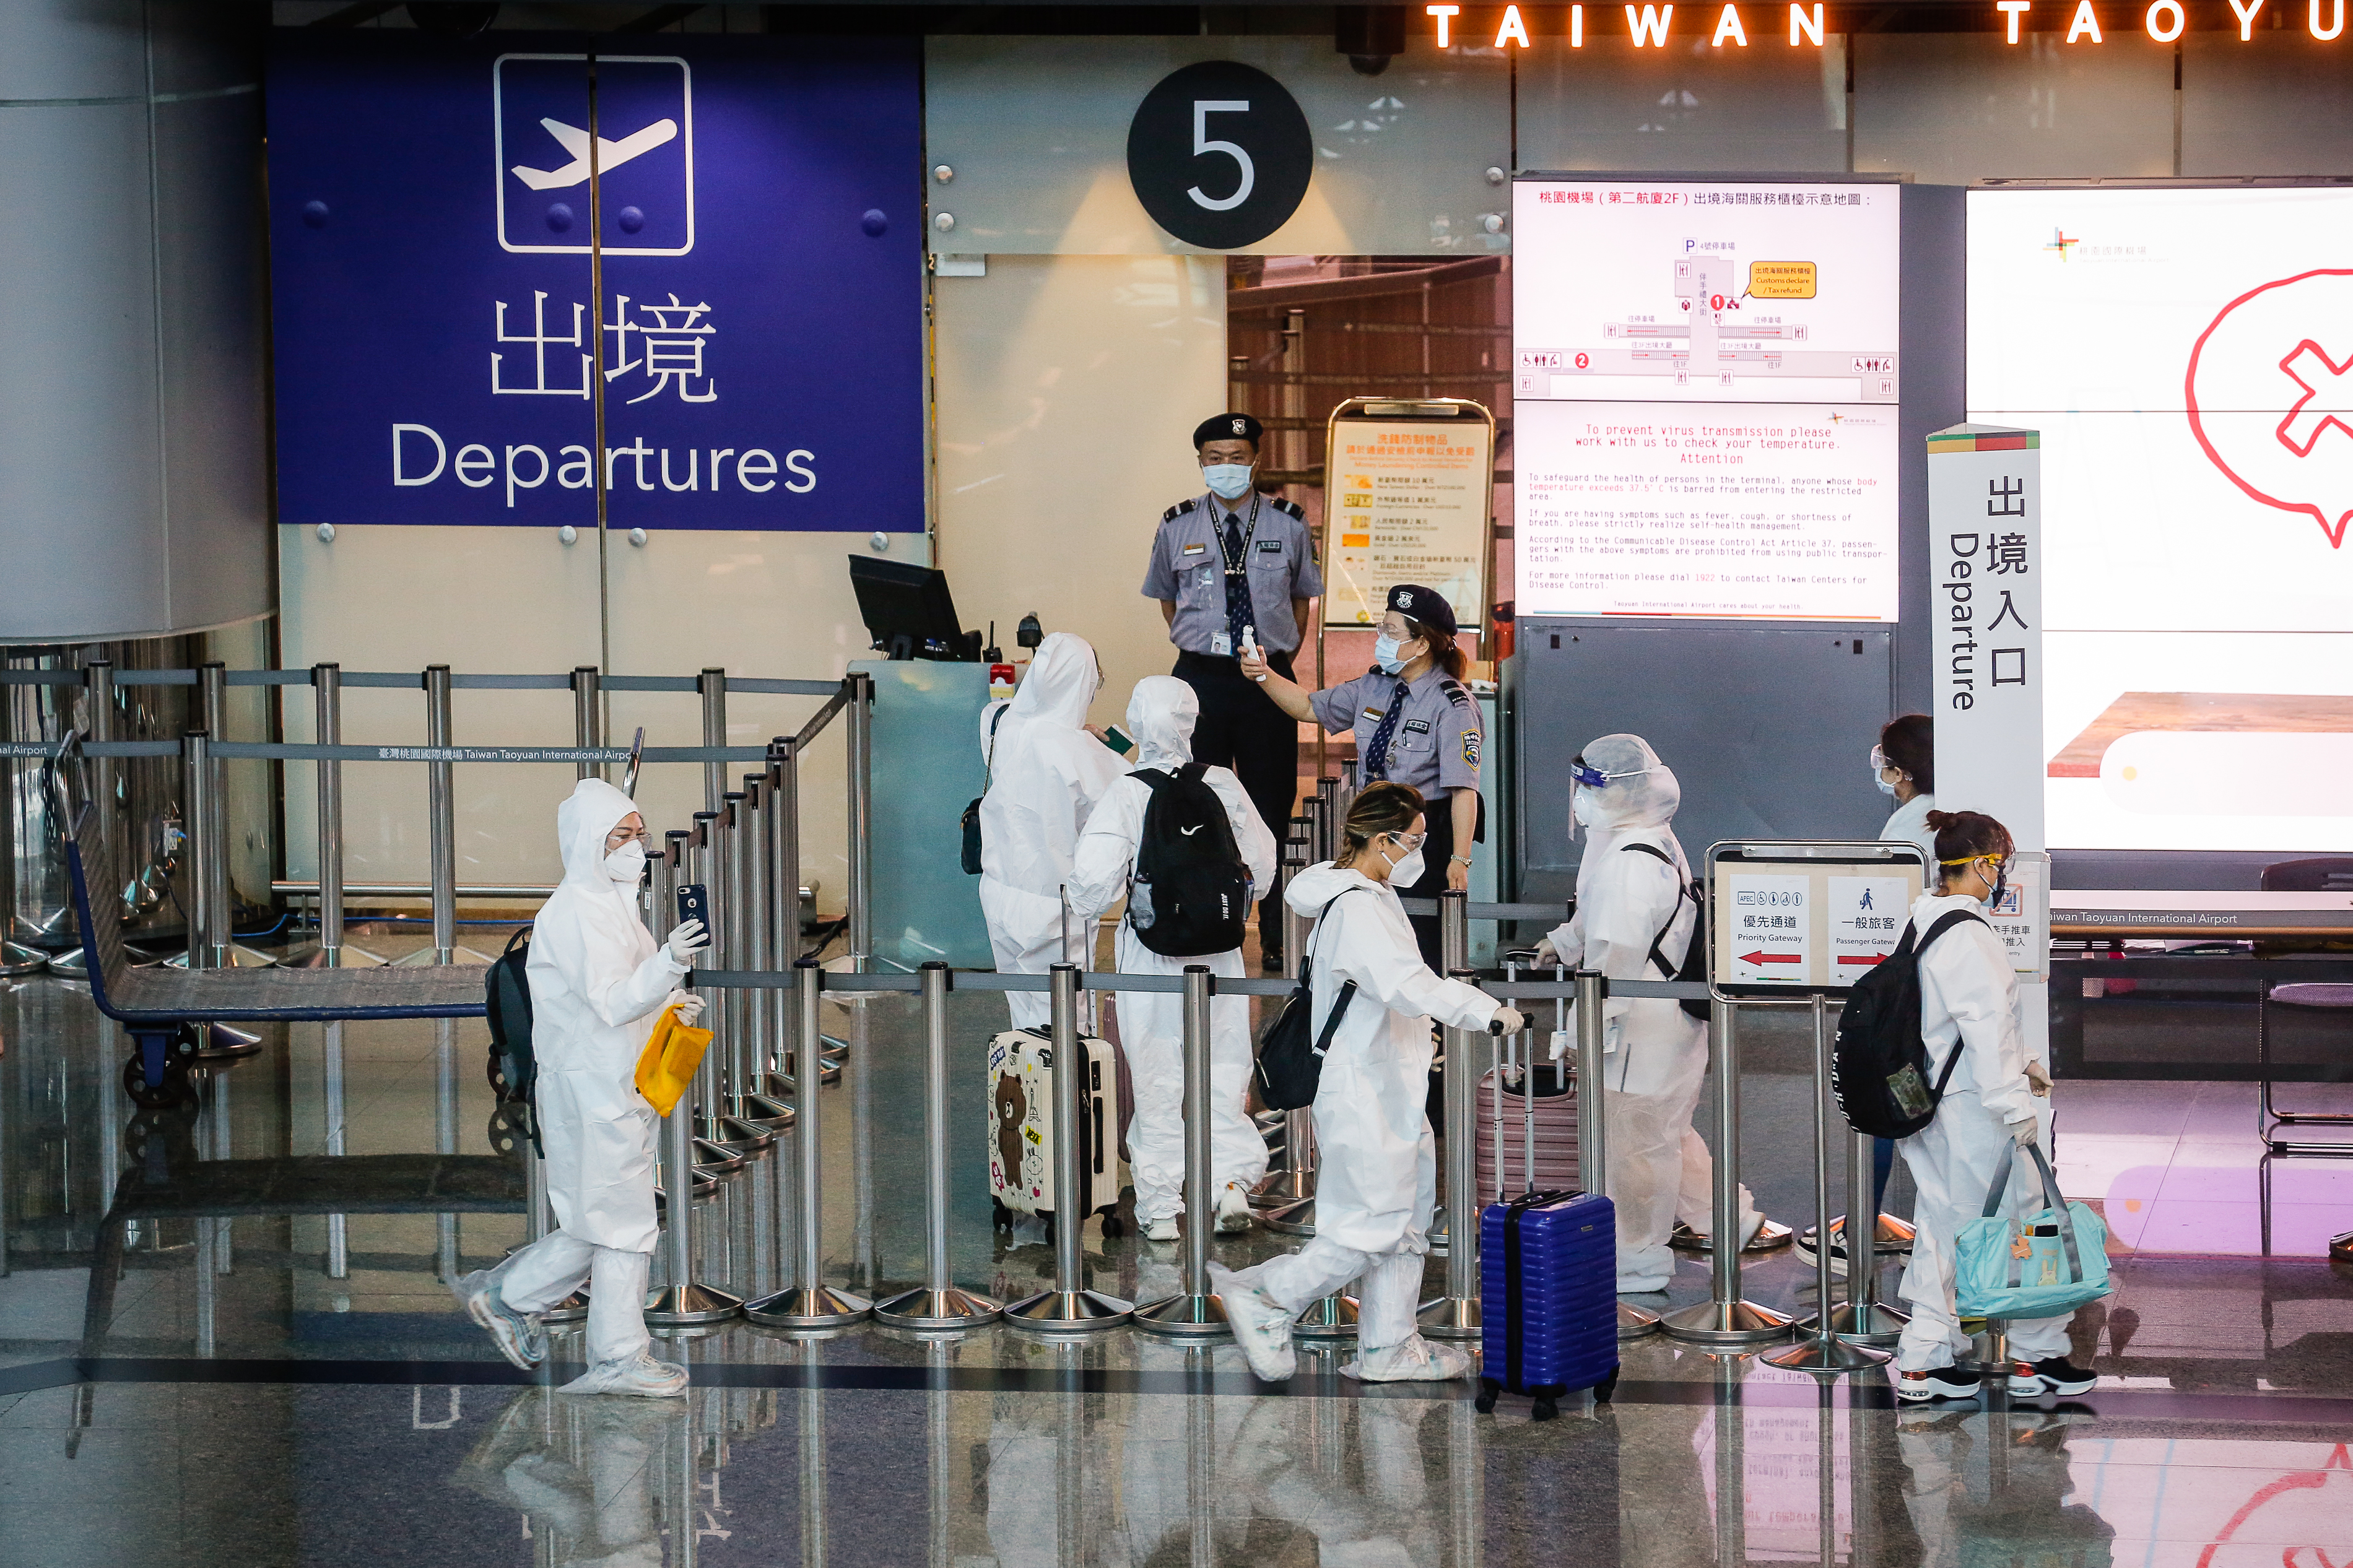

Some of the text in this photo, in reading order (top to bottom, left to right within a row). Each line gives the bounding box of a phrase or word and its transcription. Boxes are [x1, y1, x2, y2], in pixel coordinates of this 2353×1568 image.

[1426, 2, 1824, 48] TAIWAN
[1187, 100, 1255, 212] 5
[1686, 240, 1695, 252] P
[491, 290, 717, 405] 出境
[1586, 423, 1832, 438] To prevent virus transmission please
[1575, 436, 1840, 450] work with us to check your temperature.
[393, 423, 817, 507] Departures
[1680, 453, 1743, 464] Attention
[1529, 472, 1539, 481] To
[1544, 473, 1589, 482] safeguard
[1594, 474, 1609, 482] the
[1614, 474, 1645, 483] health
[1649, 474, 1659, 483] of
[1705, 475, 1715, 483] in
[1720, 475, 1735, 484] the
[1791, 478, 1822, 486] anyone
[1826, 477, 1853, 485] whose
[1857, 477, 1877, 487] body
[1529, 483, 1584, 492] temperature
[1659, 484, 1664, 492] C
[1669, 484, 1679, 493] is
[1684, 485, 1714, 493] barred
[1720, 485, 1740, 493] from
[1744, 486, 1785, 495] entering
[1791, 486, 1806, 495] the
[1811, 487, 1861, 495] restricted
[1529, 508, 1539, 517] If
[1544, 510, 1559, 518] you
[1584, 509, 1614, 519] having
[1619, 511, 1659, 519] symptoms
[1664, 511, 1685, 519] such
[1791, 513, 1837, 521] shortness
[1842, 513, 1851, 521] of
[1569, 519, 1599, 527] please
[1604, 519, 1645, 529] strictly
[1650, 520, 1685, 529] realize
[1690, 521, 1746, 530] self-health
[1751, 522, 1805, 531] management.
[1529, 535, 1574, 544] According
[1580, 536, 1590, 544] to
[1594, 536, 1609, 544] the
[1614, 536, 1675, 545] Communicable
[1679, 537, 1715, 546] Disease
[1720, 538, 1755, 547] Control
[1760, 539, 1776, 547] Act
[1781, 539, 1816, 548] Article
[1529, 554, 1563, 563] tation.
[1554, 545, 1574, 553] with
[1580, 545, 1594, 553] the
[1599, 546, 1624, 554] above
[1630, 547, 1669, 555] symptoms
[1695, 547, 1746, 556] prohibited
[1751, 548, 1771, 557] from
[1776, 548, 1801, 558] using
[1806, 548, 1837, 558] public
[1842, 550, 1887, 559] transpor-
[1529, 571, 1544, 579] For
[1575, 571, 1630, 580] information
[1635, 572, 1665, 581] please
[1669, 573, 1689, 581] dial
[1695, 573, 1715, 582] 1922
[1721, 574, 1730, 582] to
[1735, 574, 1770, 583] contact
[1777, 574, 1806, 583] Taiwan
[1811, 575, 1847, 584] Centers
[1853, 576, 1867, 584] for
[1986, 475, 2029, 687] 出境入口
[1529, 580, 1608, 589] Disease Control.
[1942, 533, 1979, 710] Departure
[12, 745, 48, 756] Airport
[464, 749, 498, 759] Taiwan
[500, 749, 540, 761] Taoyuan
[542, 750, 602, 760] International
[604, 750, 632, 761] Airpo
[1220, 893, 1229, 906] JUST
[1743, 915, 1796, 928] 優先通道
[1842, 917, 1895, 929] 一般旅客
[2050, 912, 2237, 925] aiwan Taoyuan International Airport
[1738, 933, 1803, 943] Priority Gateway
